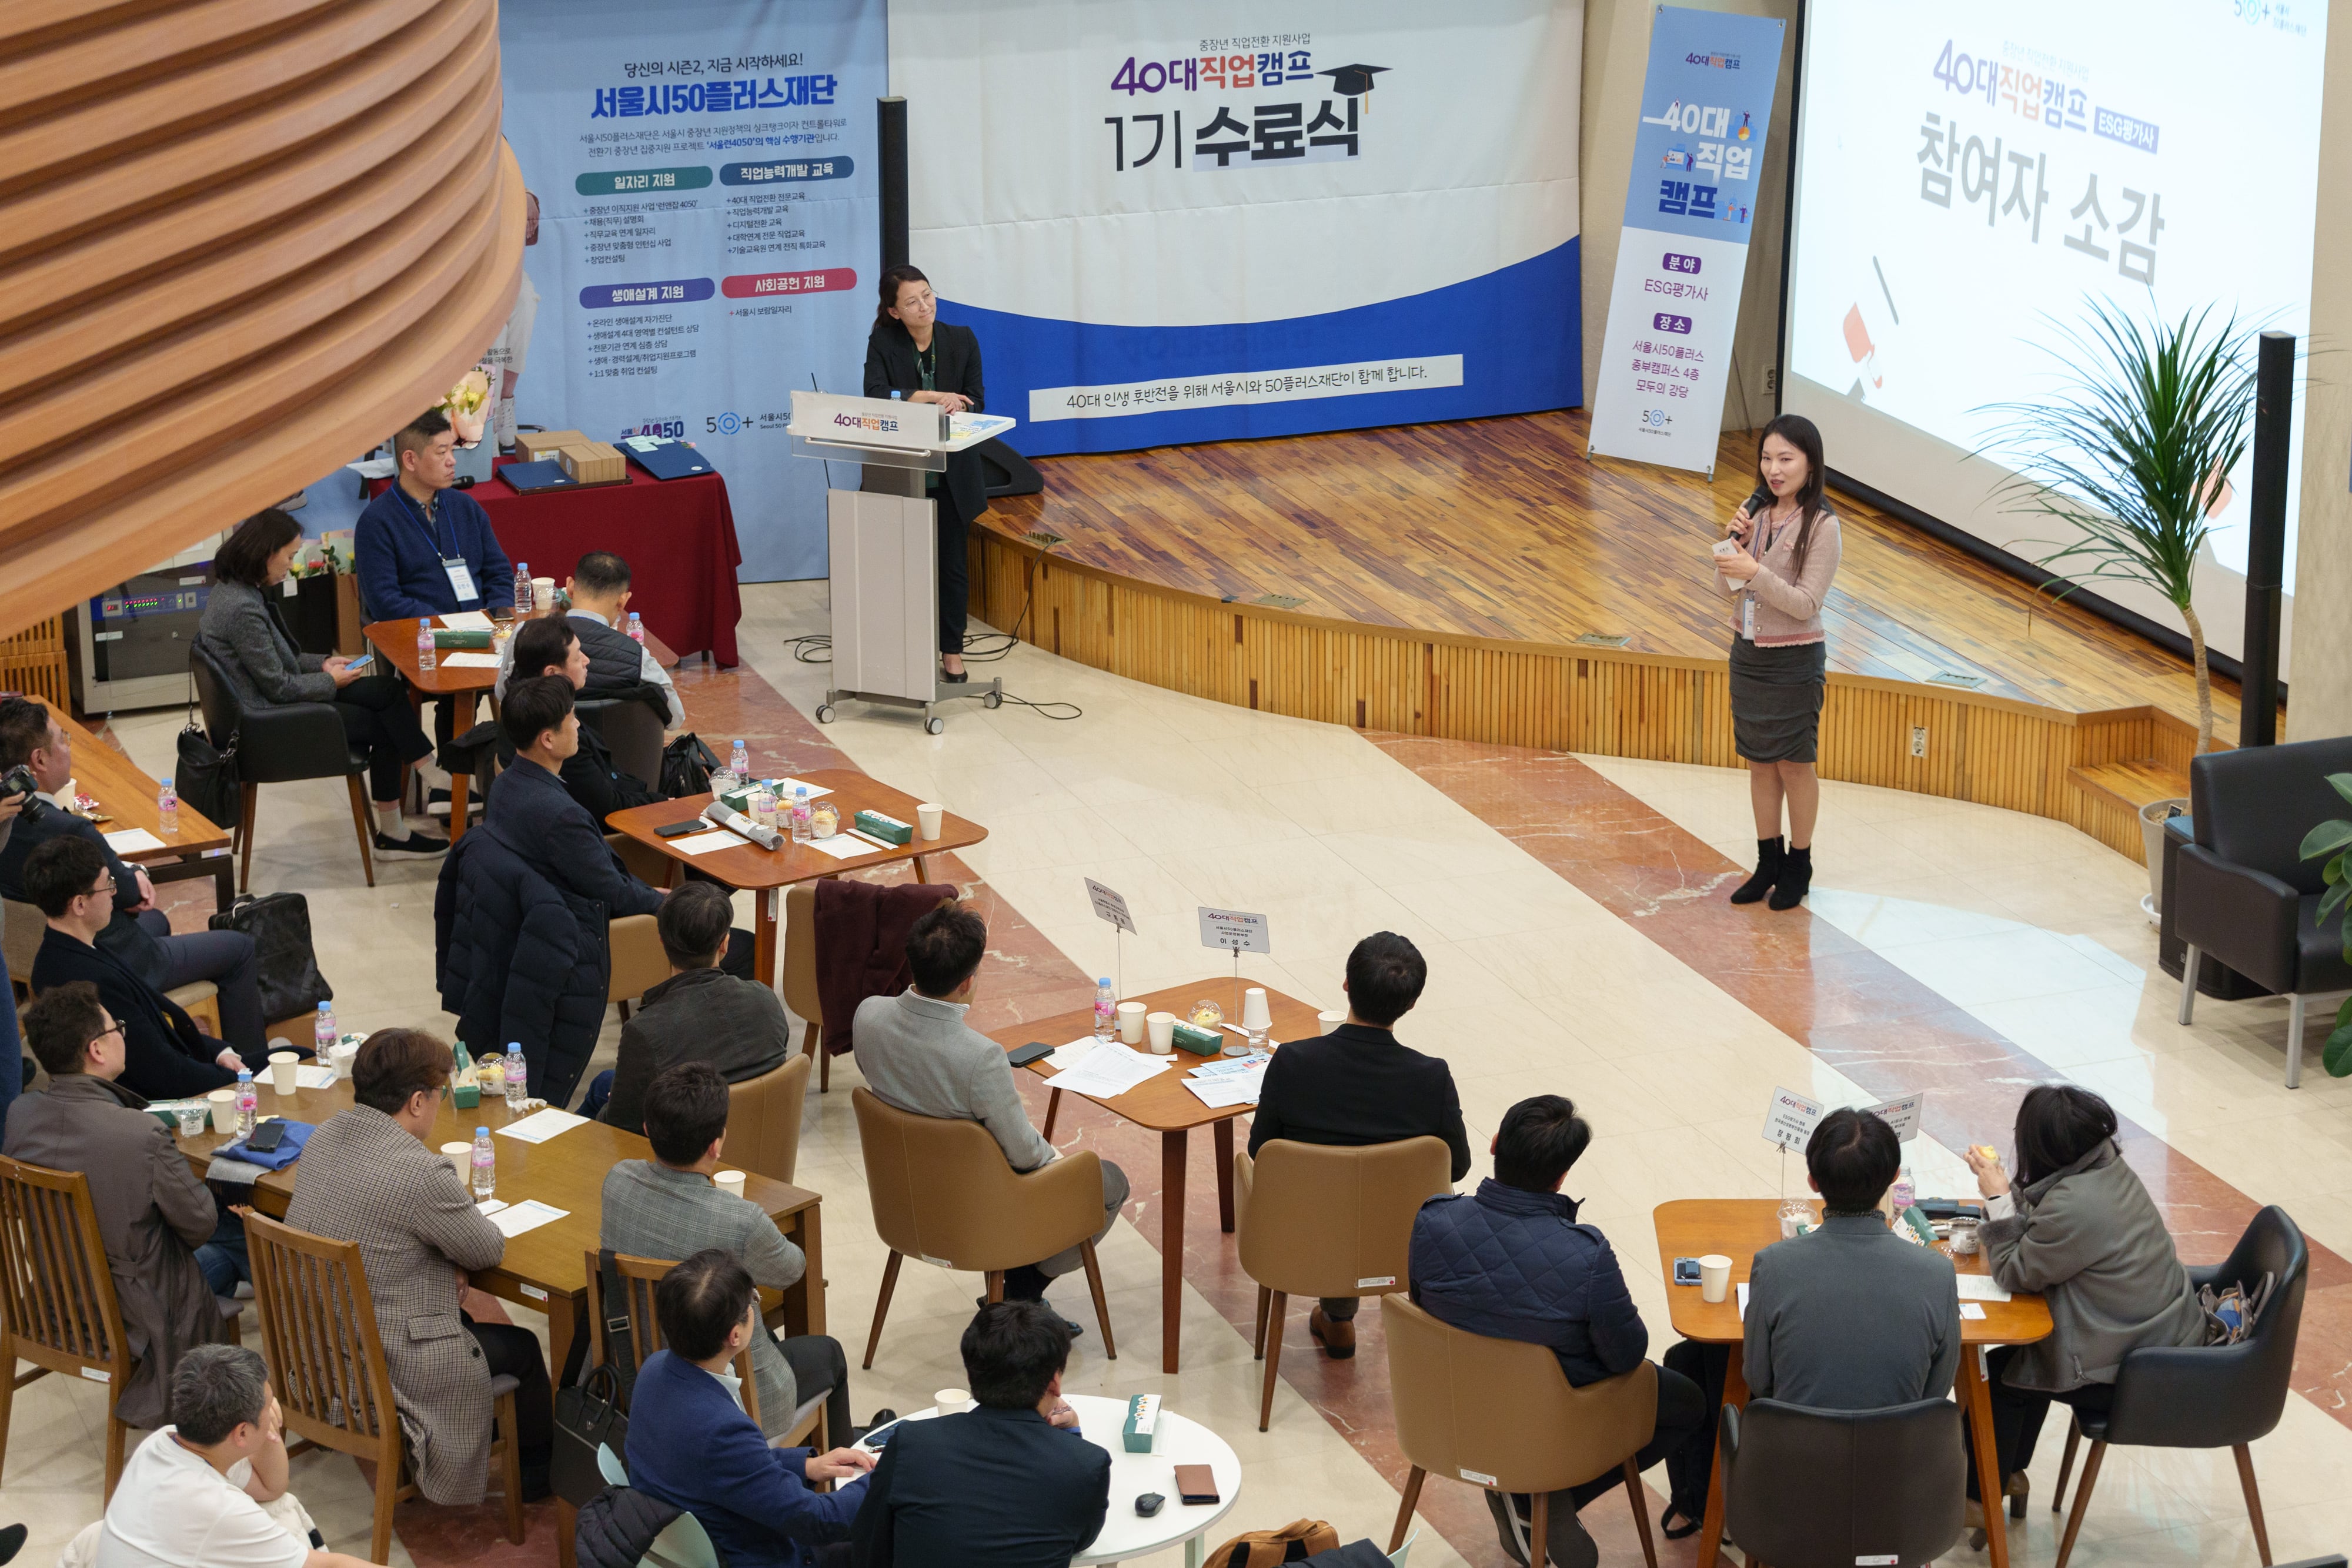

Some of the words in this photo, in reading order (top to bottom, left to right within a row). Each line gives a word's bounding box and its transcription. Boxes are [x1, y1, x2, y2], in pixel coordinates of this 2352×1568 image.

[1199, 39, 1229, 52] 중장년
[1231, 35, 1270, 49] 직업전환
[1272, 32, 1311, 46] 지원사업
[624, 61, 664, 78] 당신의
[667, 60, 704, 75] 시즌2,
[707, 58, 733, 72] 지금
[736, 53, 803, 71] 시작하세요!
[1685, 52, 1740, 69] 40대직업캠프
[1110, 50, 1314, 96] 40대직업캠프
[1933, 39, 2087, 133] 40대직업캠프
[591, 74, 838, 119] 서울시50플러스재단
[1642, 101, 1730, 139] 40대
[580, 130, 660, 144] 서울시50플러스재단은
[662, 129, 685, 139] 서울시
[687, 126, 711, 138] 중장년
[713, 123, 751, 136] 지원정책의
[753, 121, 799, 133] 싱크탱크이자
[801, 118, 847, 129] 컨트롤타워로
[1104, 109, 1182, 172] 1기
[1195, 97, 1359, 167] 수료식
[2098, 112, 2154, 150] ESG평가사
[589, 147, 612, 158] 전환기
[614, 145, 638, 156] 중장년
[640, 143, 671, 155] 집중지원
[673, 141, 705, 152] 프로젝트
[765, 135, 781, 146] 핵심
[783, 133, 840, 145] 수행기관입니다.
[741, 163, 808, 180] 직업능력개발
[812, 162, 834, 176] 교육
[1695, 141, 1753, 185] 직업
[614, 175, 649, 190] 일자리
[653, 173, 676, 188] 지원
[731, 196, 748, 205] 40대
[749, 194, 776, 204] 직업전환
[777, 192, 806, 202] 전문교육
[1659, 179, 1718, 219] 캠프
[1916, 111, 2049, 245] 참여자
[2063, 172, 2166, 287] 소감
[589, 205, 610, 215] 중장년
[612, 204, 640, 213] 이직지원
[642, 202, 655, 212] 사업
[732, 206, 774, 216] 직업능력개발
[775, 205, 789, 213] 교육
[589, 216, 622, 226] 채용(직무)
[623, 215, 644, 225] 설명회
[733, 219, 767, 229] 디지털전환
[769, 218, 783, 227] 교육
[589, 229, 617, 239] 직무교육
[619, 228, 633, 237] 연계
[634, 227, 656, 236] 일자리
[733, 232, 761, 242] 대학연계
[762, 231, 776, 240] 전문
[777, 230, 805, 239] 직업교육
[590, 242, 612, 252] 중장년
[613, 241, 634, 250] 맞춤형
[635, 240, 656, 249] 인턴십
[657, 238, 671, 247] 사업
[732, 244, 767, 255] 기술교육원
[768, 243, 782, 252] 연계
[783, 242, 797, 250] 전직
[799, 240, 826, 250] 특화교육
[591, 254, 626, 265] 창업컨설팅
[1668, 255, 1696, 272] 분야
[755, 277, 800, 292] 사회공헌
[803, 275, 825, 289] 지원
[1644, 279, 1709, 301] ESG평가사
[612, 287, 657, 303] 생애설계
[661, 285, 684, 299] 지원
[735, 307, 756, 317] 서울시
[757, 305, 792, 316] 보람일자리
[593, 318, 613, 327] 온라인
[615, 316, 643, 326] 생애설계
[644, 314, 673, 324] 자가진단
[1659, 316, 1686, 332] 장소
[593, 330, 622, 340] 생애설계
[622, 329, 633, 337] 4대
[634, 327, 656, 337] 영역별
[657, 325, 685, 336] 컨설턴트
[686, 324, 700, 333] 상담
[593, 343, 621, 353] 전문기관
[622, 342, 637, 351] 연계
[639, 340, 653, 350] 심층
[654, 339, 668, 349] 상담
[1632, 340, 1705, 363] 서울시50플러스
[606, 368, 619, 377] 맞춤
[620, 367, 634, 376] 취업
[636, 366, 658, 375] 컨설팅
[1631, 359, 1680, 377] 중부캠퍼스
[1683, 367, 1700, 381] 4층
[1067, 394, 1101, 408] 40대
[1104, 392, 1130, 407] 인생
[1133, 385, 1180, 404] 후반전을
[1183, 384, 1208, 399] 위해
[1211, 379, 1262, 396] 서울시와
[1265, 371, 1355, 393] 50플러스재단이
[1358, 368, 1384, 385] 함께
[1387, 366, 1428, 382] 합니다.
[1636, 379, 1666, 394] 모두의
[1669, 383, 1689, 398] 강당
[834, 413, 899, 432] 40대직업캠프
[1208, 913, 1258, 924] 40대직업캠프
[1780, 1096, 1817, 1116] 40대직업캠프
